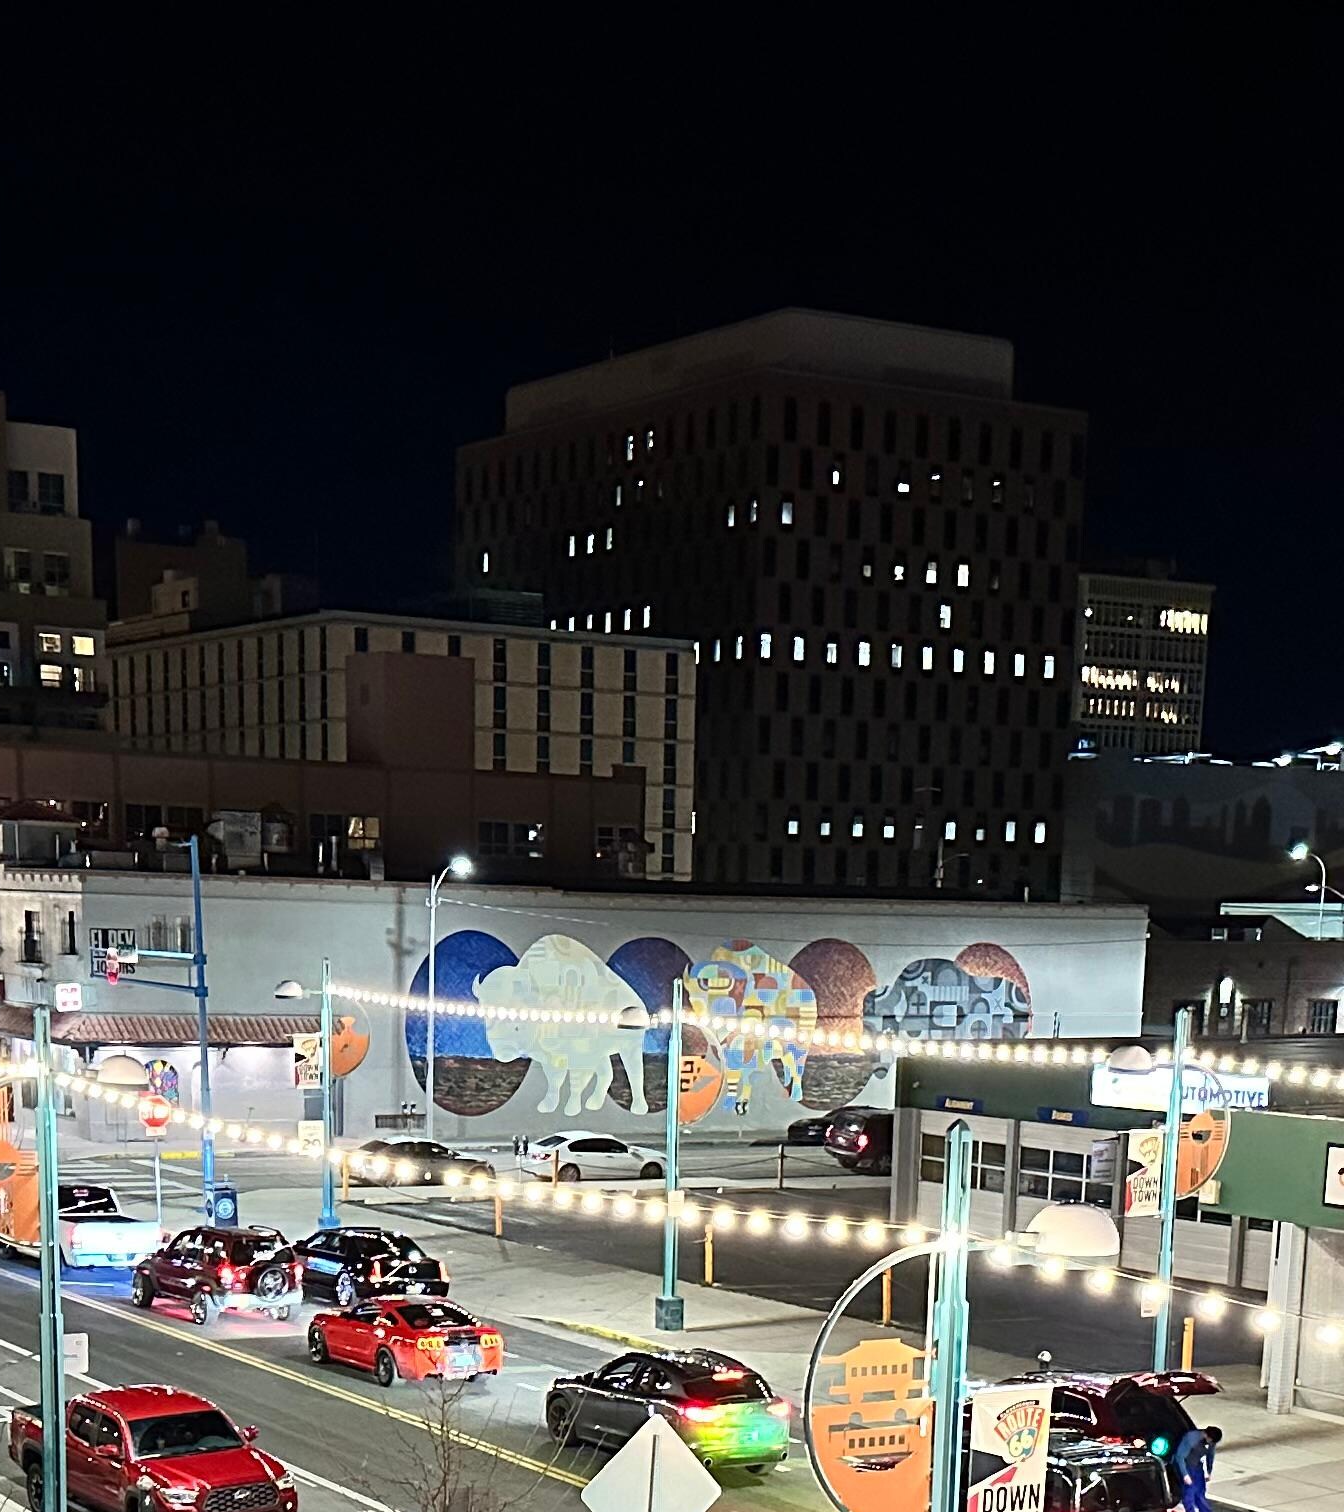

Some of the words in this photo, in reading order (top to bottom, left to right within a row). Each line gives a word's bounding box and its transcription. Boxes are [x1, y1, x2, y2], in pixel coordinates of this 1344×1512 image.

[1181, 1086, 1265, 1106] UTOMOTIVE
[1133, 1176, 1159, 1189] DOWN
[1133, 1189, 1157, 1202] TOWN
[996, 1407, 1043, 1439] ROUTE
[1008, 1428, 1035, 1458] 66
